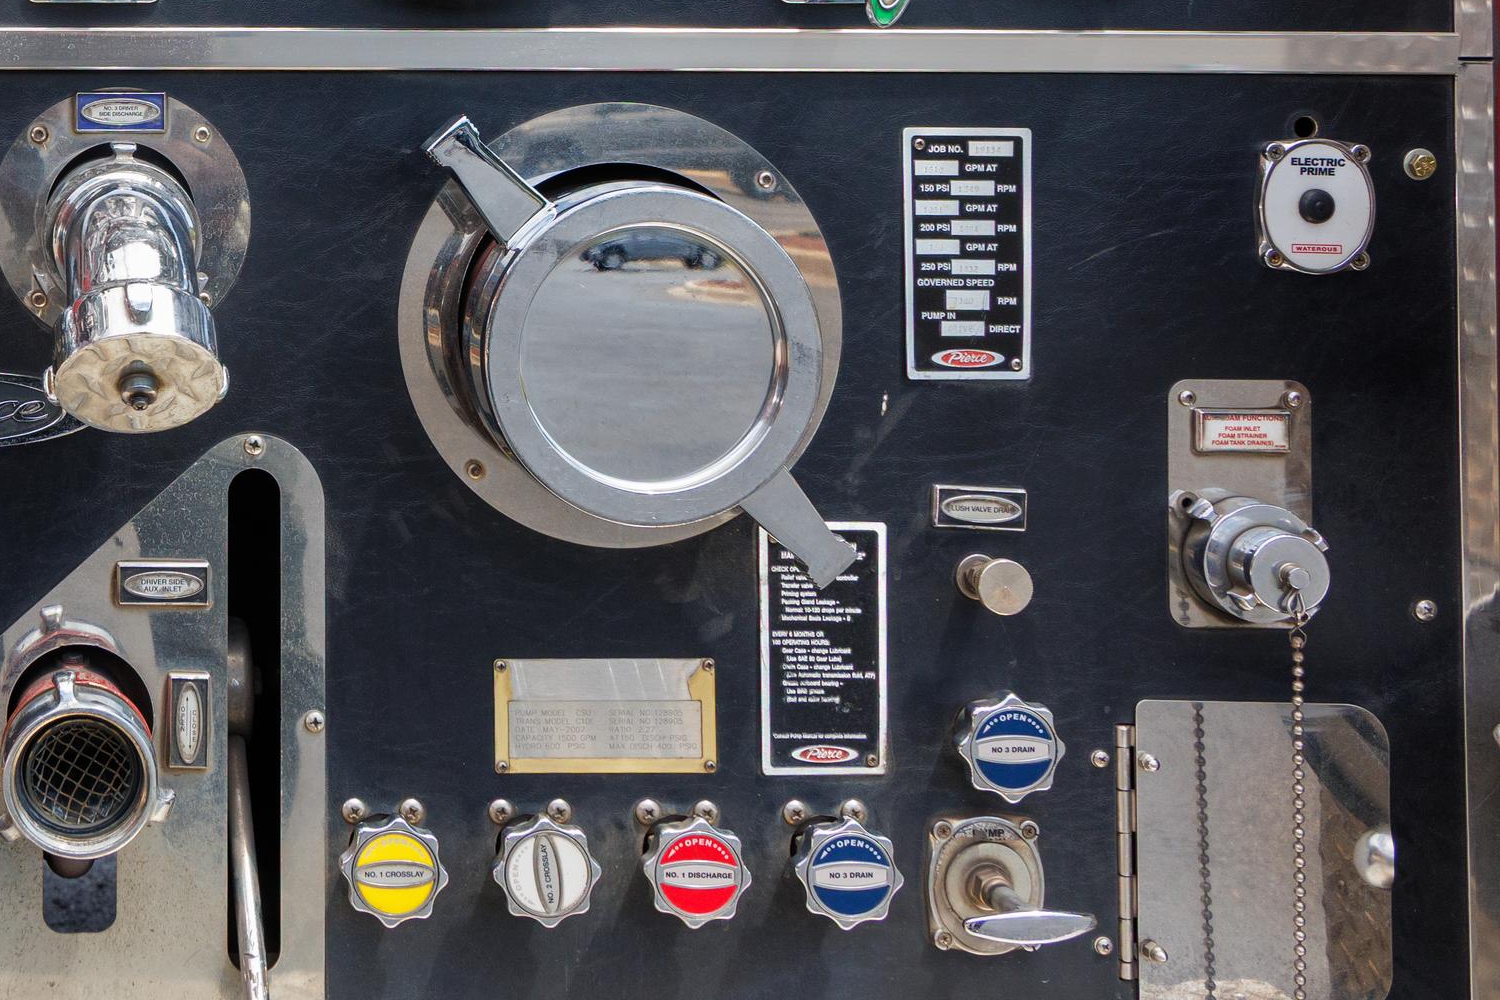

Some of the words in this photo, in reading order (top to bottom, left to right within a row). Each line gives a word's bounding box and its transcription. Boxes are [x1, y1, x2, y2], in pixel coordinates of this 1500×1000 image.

[1291, 157, 1346, 167] ELECTRIC
[1300, 167, 1336, 176] PRIME
[920, 184, 935, 192] 150
[936, 184, 950, 192] PSI
[997, 184, 1017, 193] RPM
[917, 279, 964, 287] GOVERNED
[966, 279, 995, 287] SPEED
[989, 325, 1021, 333] DIRECT
[999, 713, 1028, 722] OPEN
[991, 746, 1003, 754] NO
[685, 839, 712, 847] OPEN
[385, 870, 425, 878] CROSSLAY
